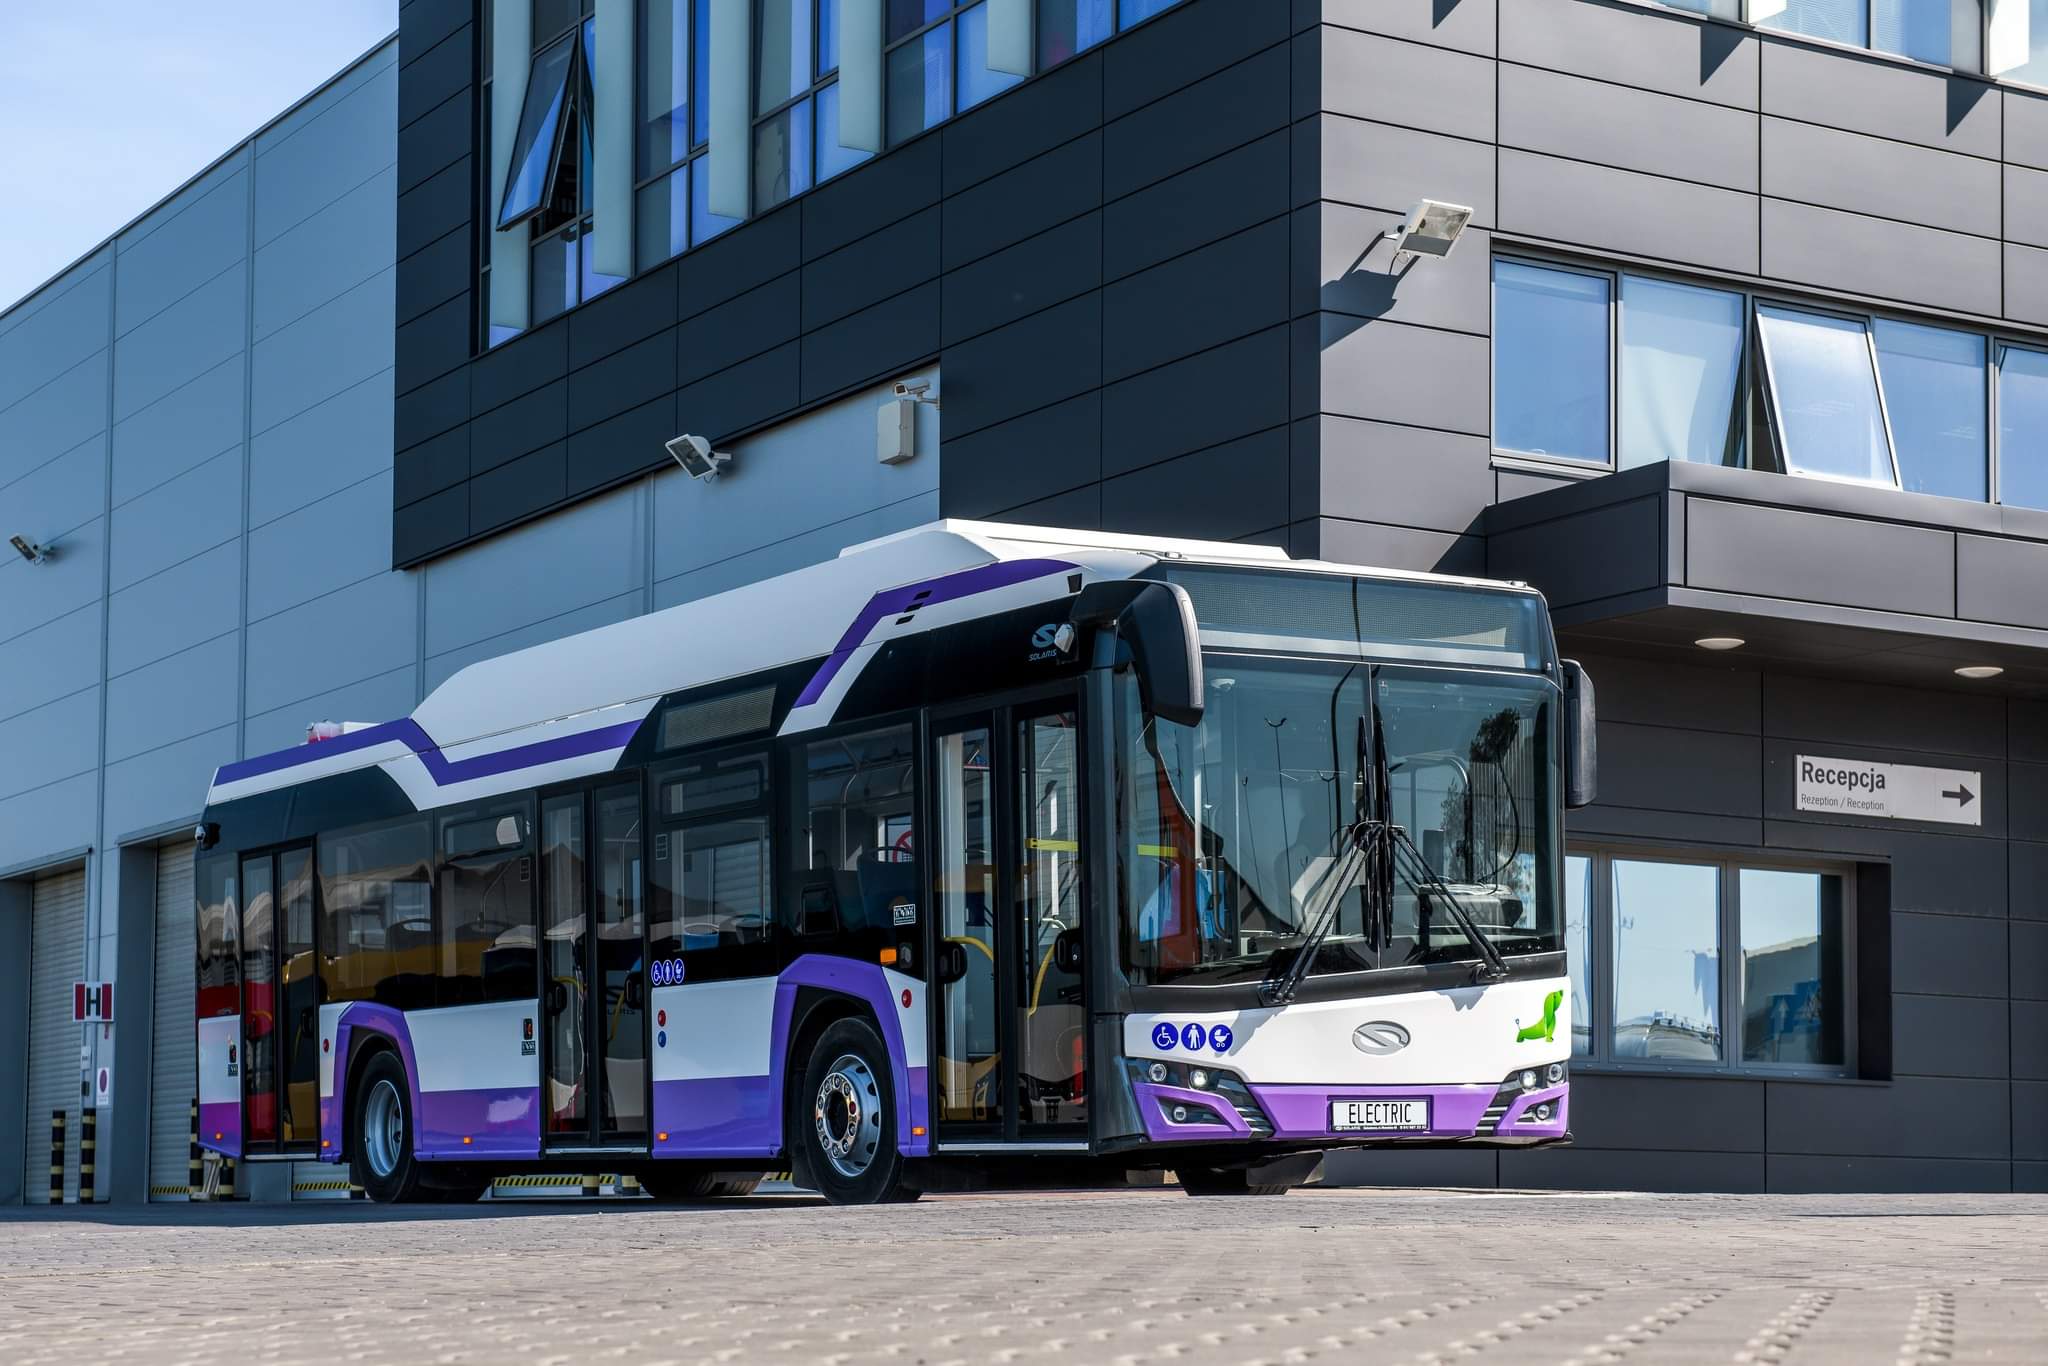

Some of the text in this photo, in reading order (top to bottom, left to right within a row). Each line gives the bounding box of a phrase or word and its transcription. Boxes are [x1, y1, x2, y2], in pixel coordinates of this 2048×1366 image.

[1028, 649, 1057, 661] SOLARIS
[1802, 761, 1885, 793] Recepcja
[1801, 793, 1838, 808] Rezeption
[1847, 797, 1885, 811] Reception
[86, 987, 101, 1016] H
[1348, 1103, 1412, 1124] ELECTRIC
